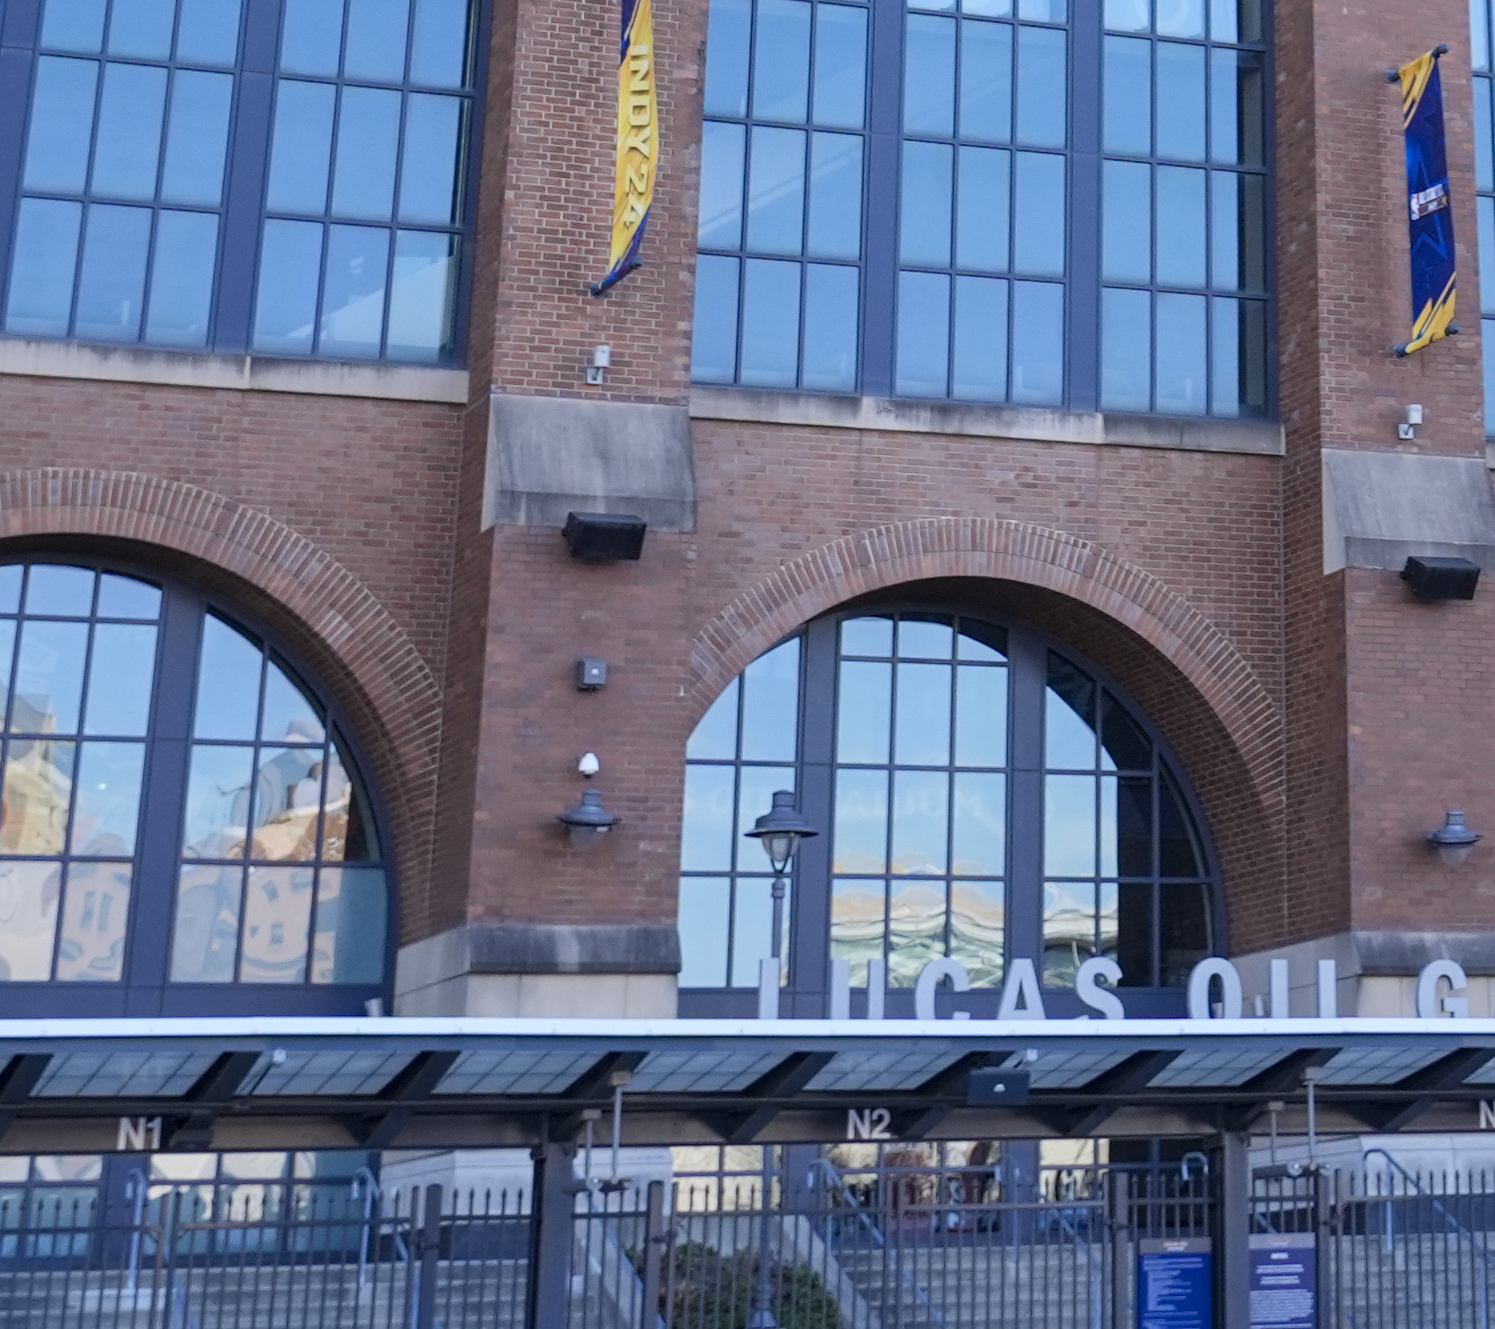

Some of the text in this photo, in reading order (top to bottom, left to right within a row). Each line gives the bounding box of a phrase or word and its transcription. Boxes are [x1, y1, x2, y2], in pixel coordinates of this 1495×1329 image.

[622, 43, 652, 229] INDY 24
[757, 955, 1124, 1022] LUCAS
[1186, 955, 1336, 1021] OIL
[115, 1115, 164, 1151] N1
[845, 1108, 892, 1140] N2
